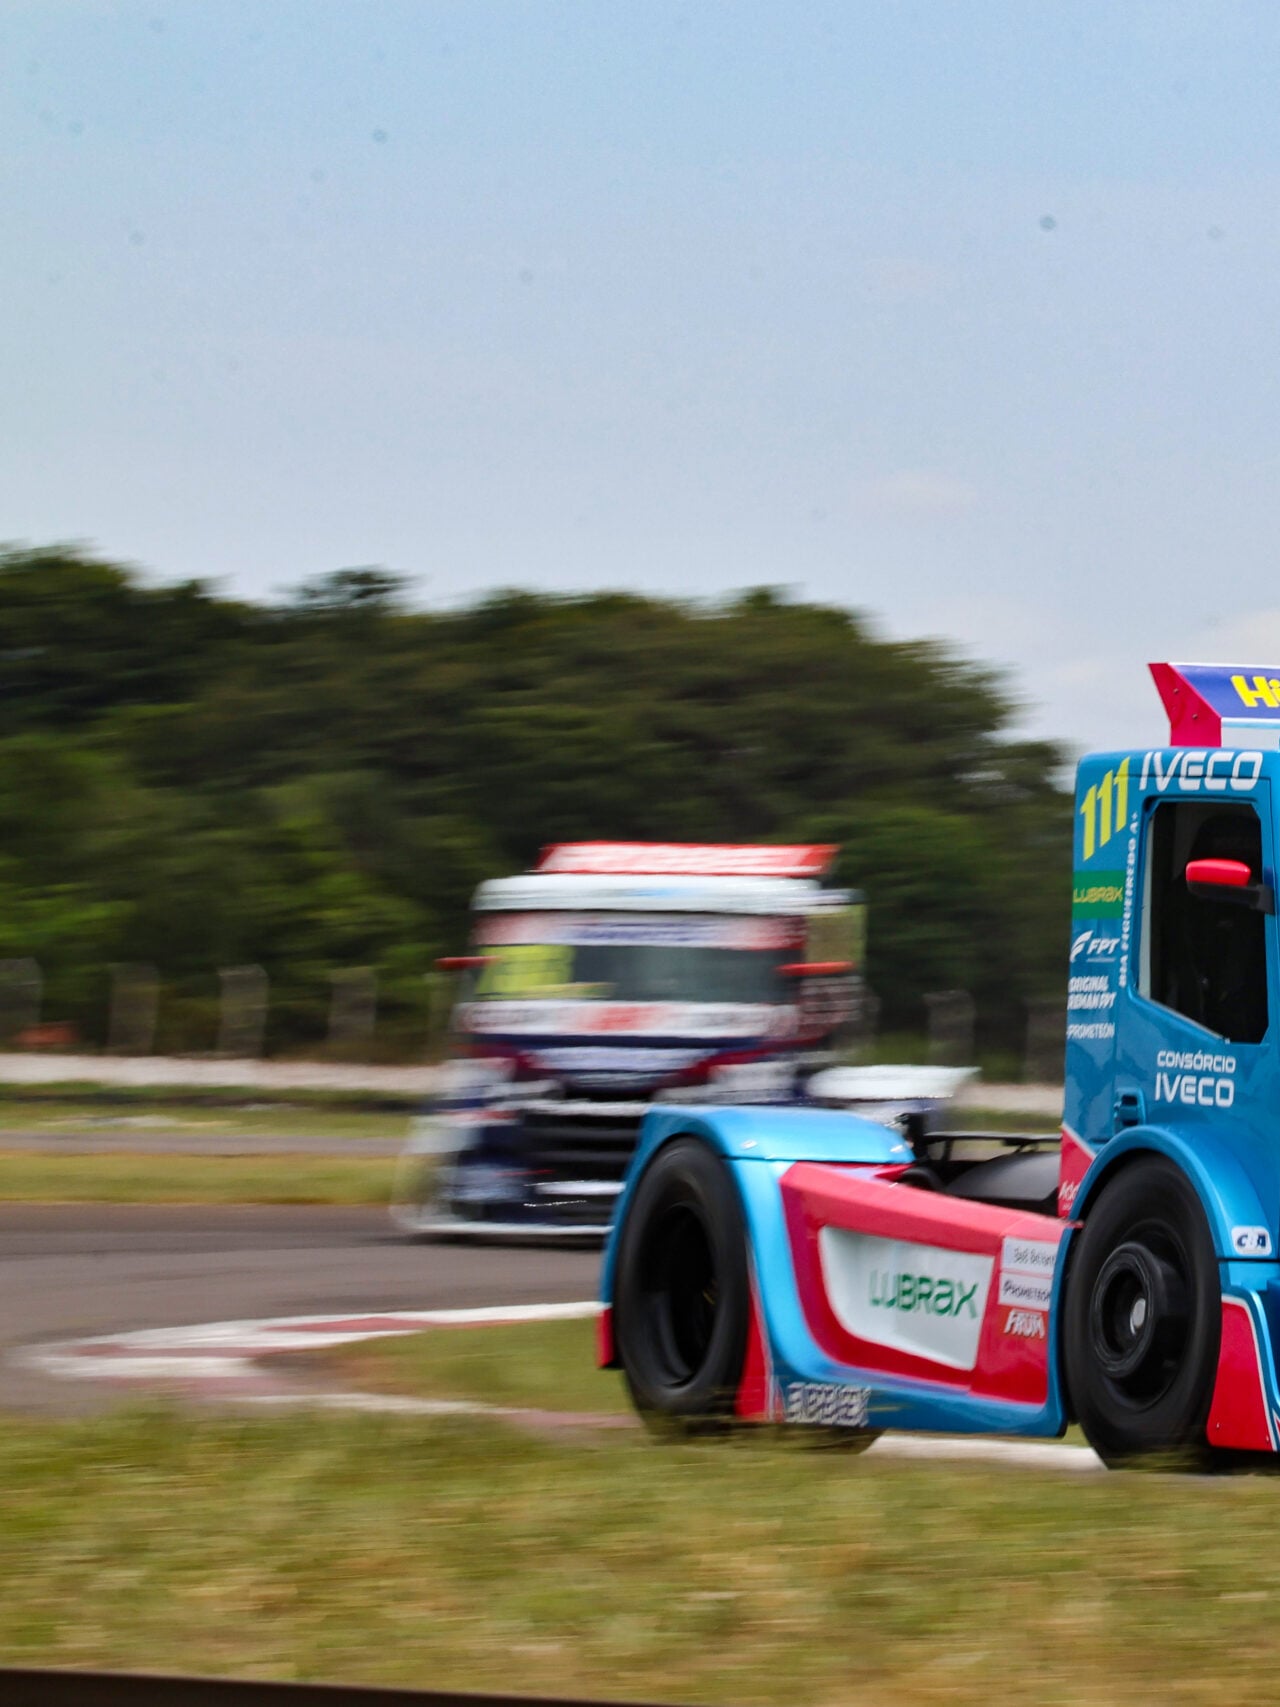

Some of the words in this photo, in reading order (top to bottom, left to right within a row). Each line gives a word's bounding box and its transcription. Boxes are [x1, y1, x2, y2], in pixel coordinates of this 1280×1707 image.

[1139, 751, 1263, 791] IVECO
[1080, 756, 1130, 861] 111
[1087, 938, 1120, 955] FPT
[1157, 1049, 1236, 1074] CONSÓRCIO
[1155, 1071, 1235, 1108] IVECO
[1236, 1233, 1267, 1248] CA
